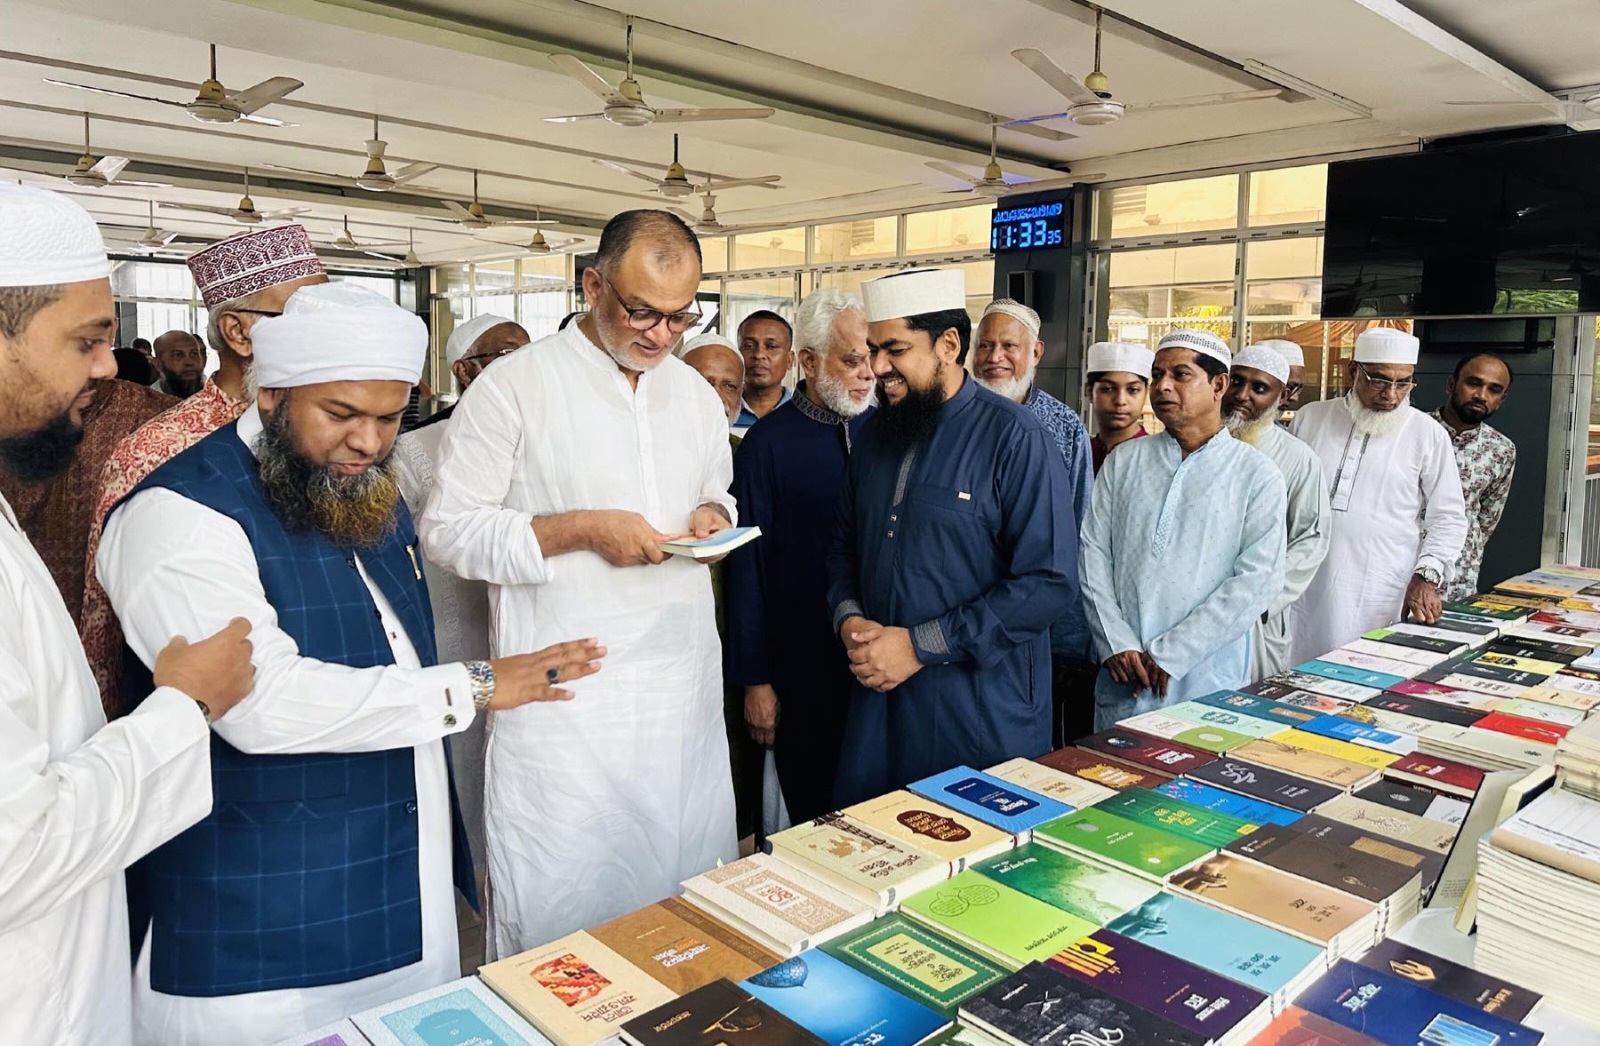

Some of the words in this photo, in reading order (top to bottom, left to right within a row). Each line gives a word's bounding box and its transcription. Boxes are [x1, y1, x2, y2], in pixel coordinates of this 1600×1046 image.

[580, 995, 637, 1022] ফাওয়াইদ
[1183, 993, 1208, 1010] রব
[602, 1006, 634, 1023] আল
